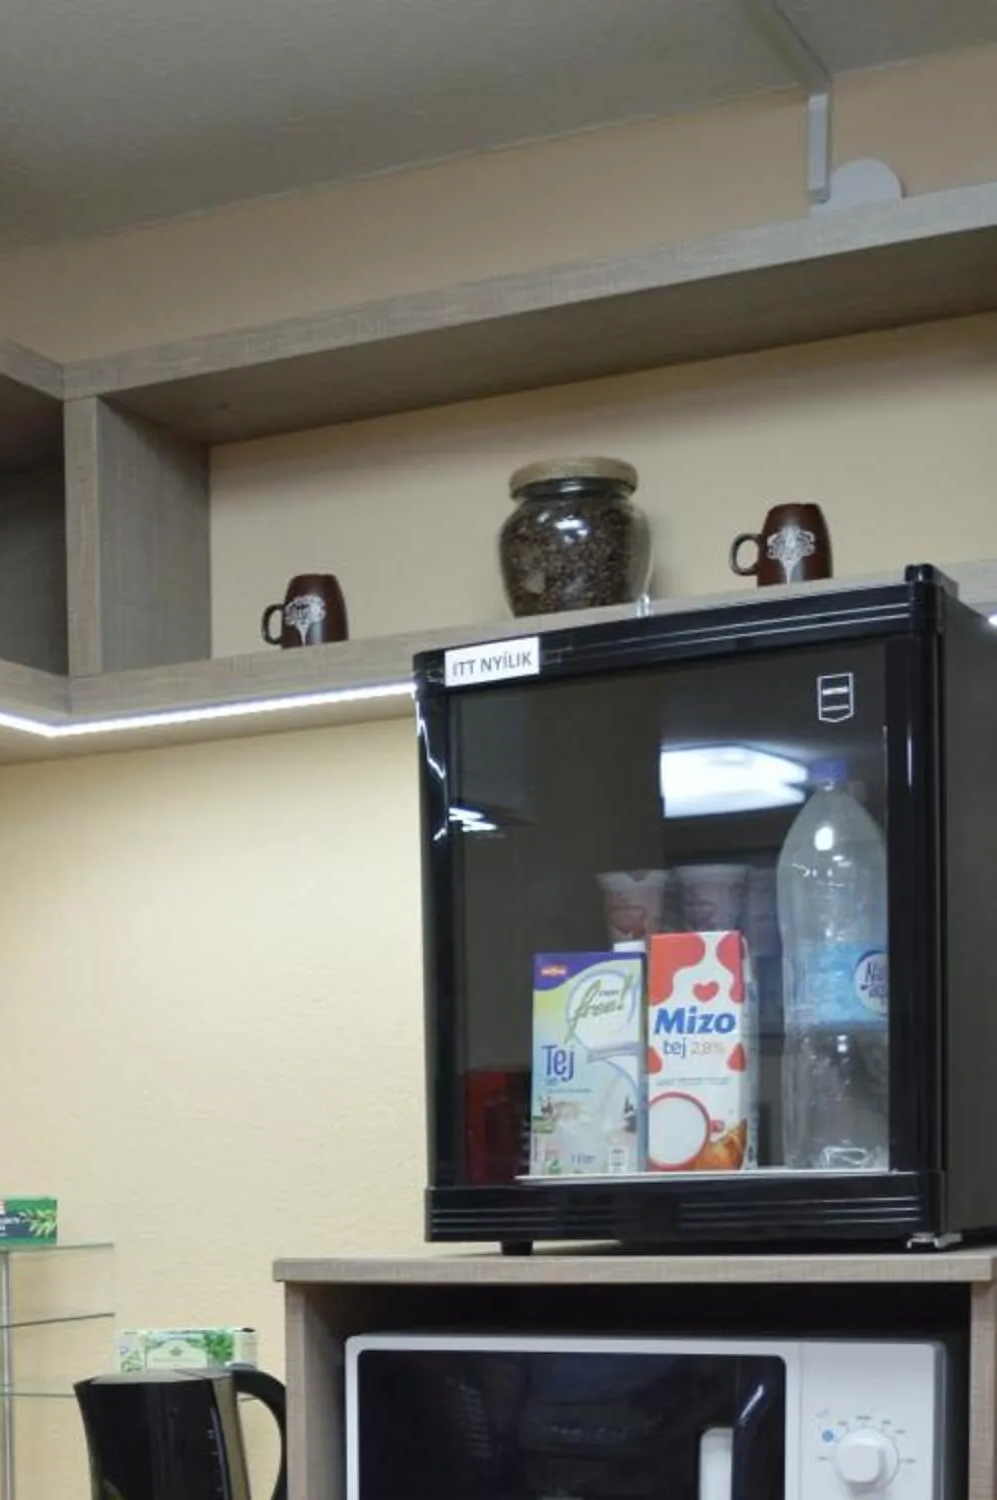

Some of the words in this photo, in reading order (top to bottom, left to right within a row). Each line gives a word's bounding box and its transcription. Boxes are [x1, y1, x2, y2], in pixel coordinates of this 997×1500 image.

[452, 660, 476, 677] ITT
[654, 1006, 736, 1035] Mizo
[663, 1036, 686, 1058] tej
[541, 1044, 575, 1082] Tej
